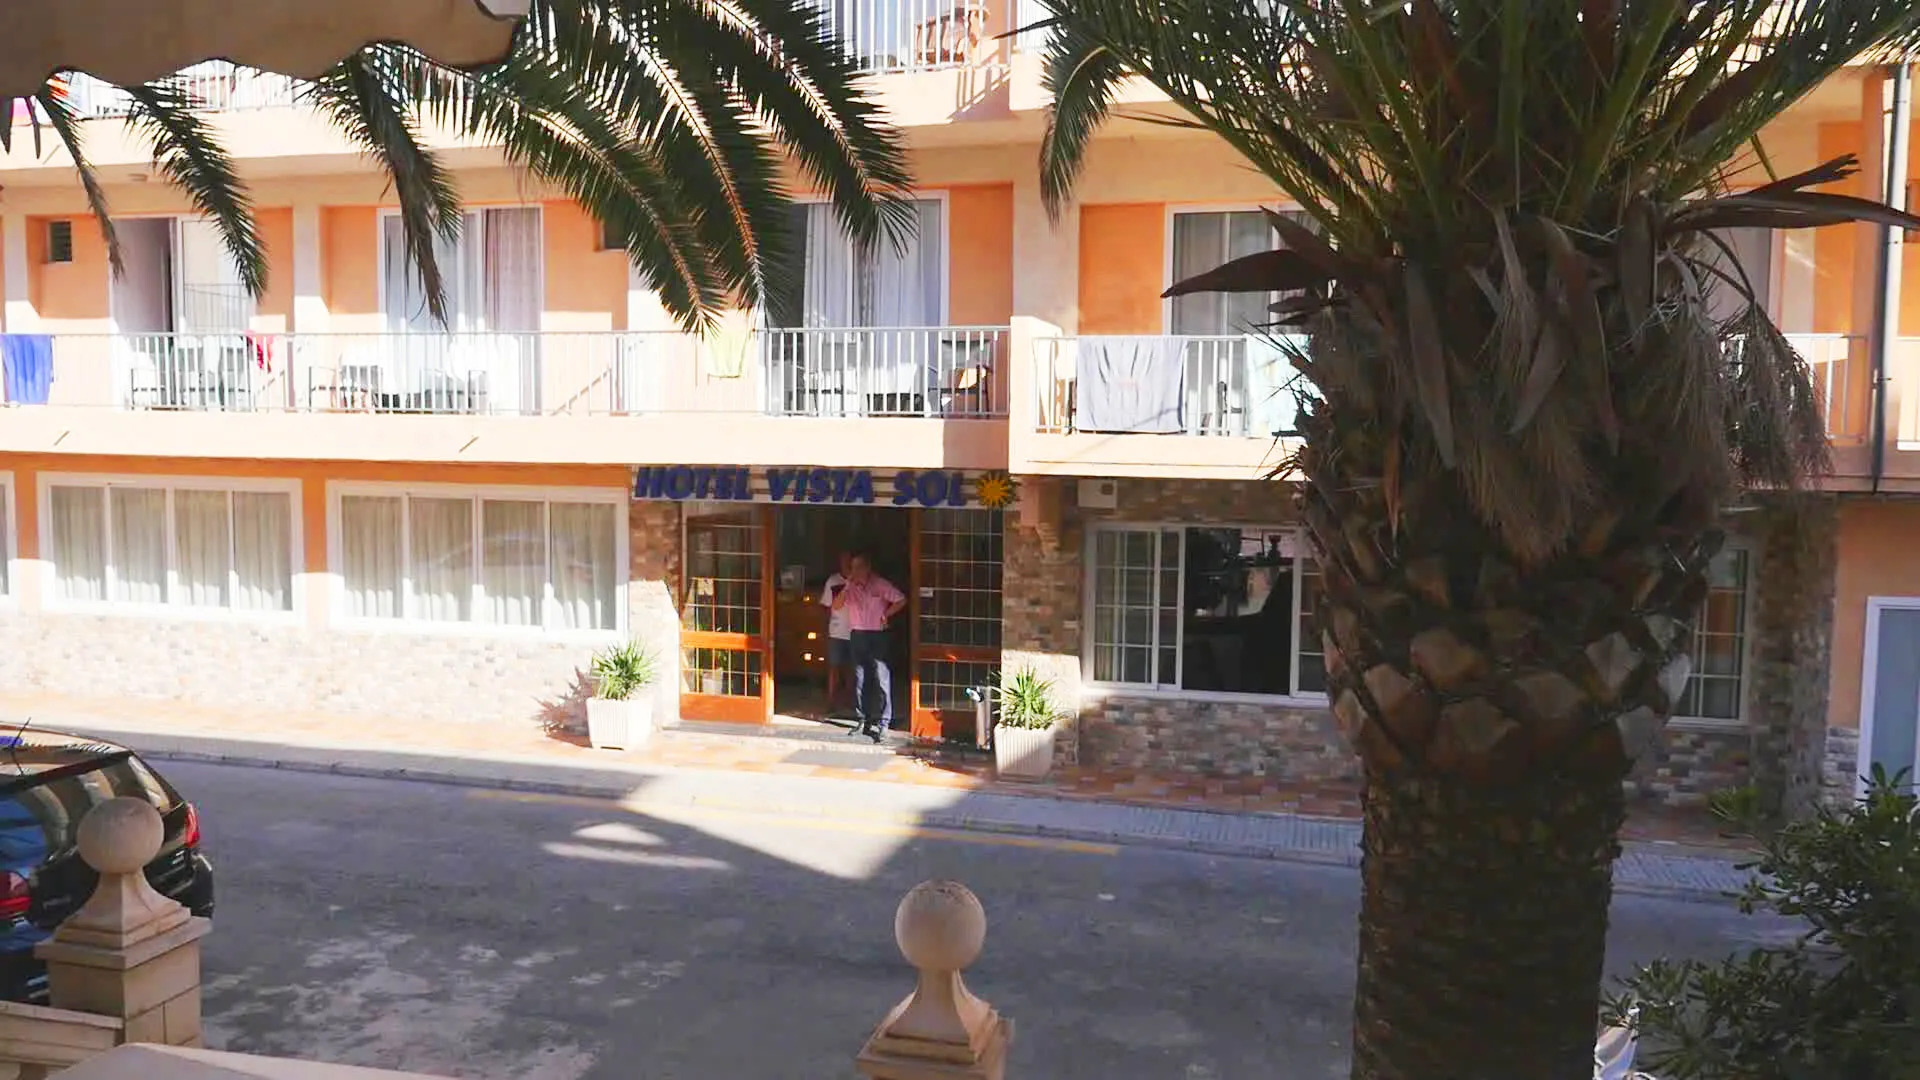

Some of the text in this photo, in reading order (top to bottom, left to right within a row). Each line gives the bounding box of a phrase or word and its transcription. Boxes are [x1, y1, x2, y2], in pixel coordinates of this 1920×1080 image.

[634, 466, 967, 507] HOTEL VISTA SOL
